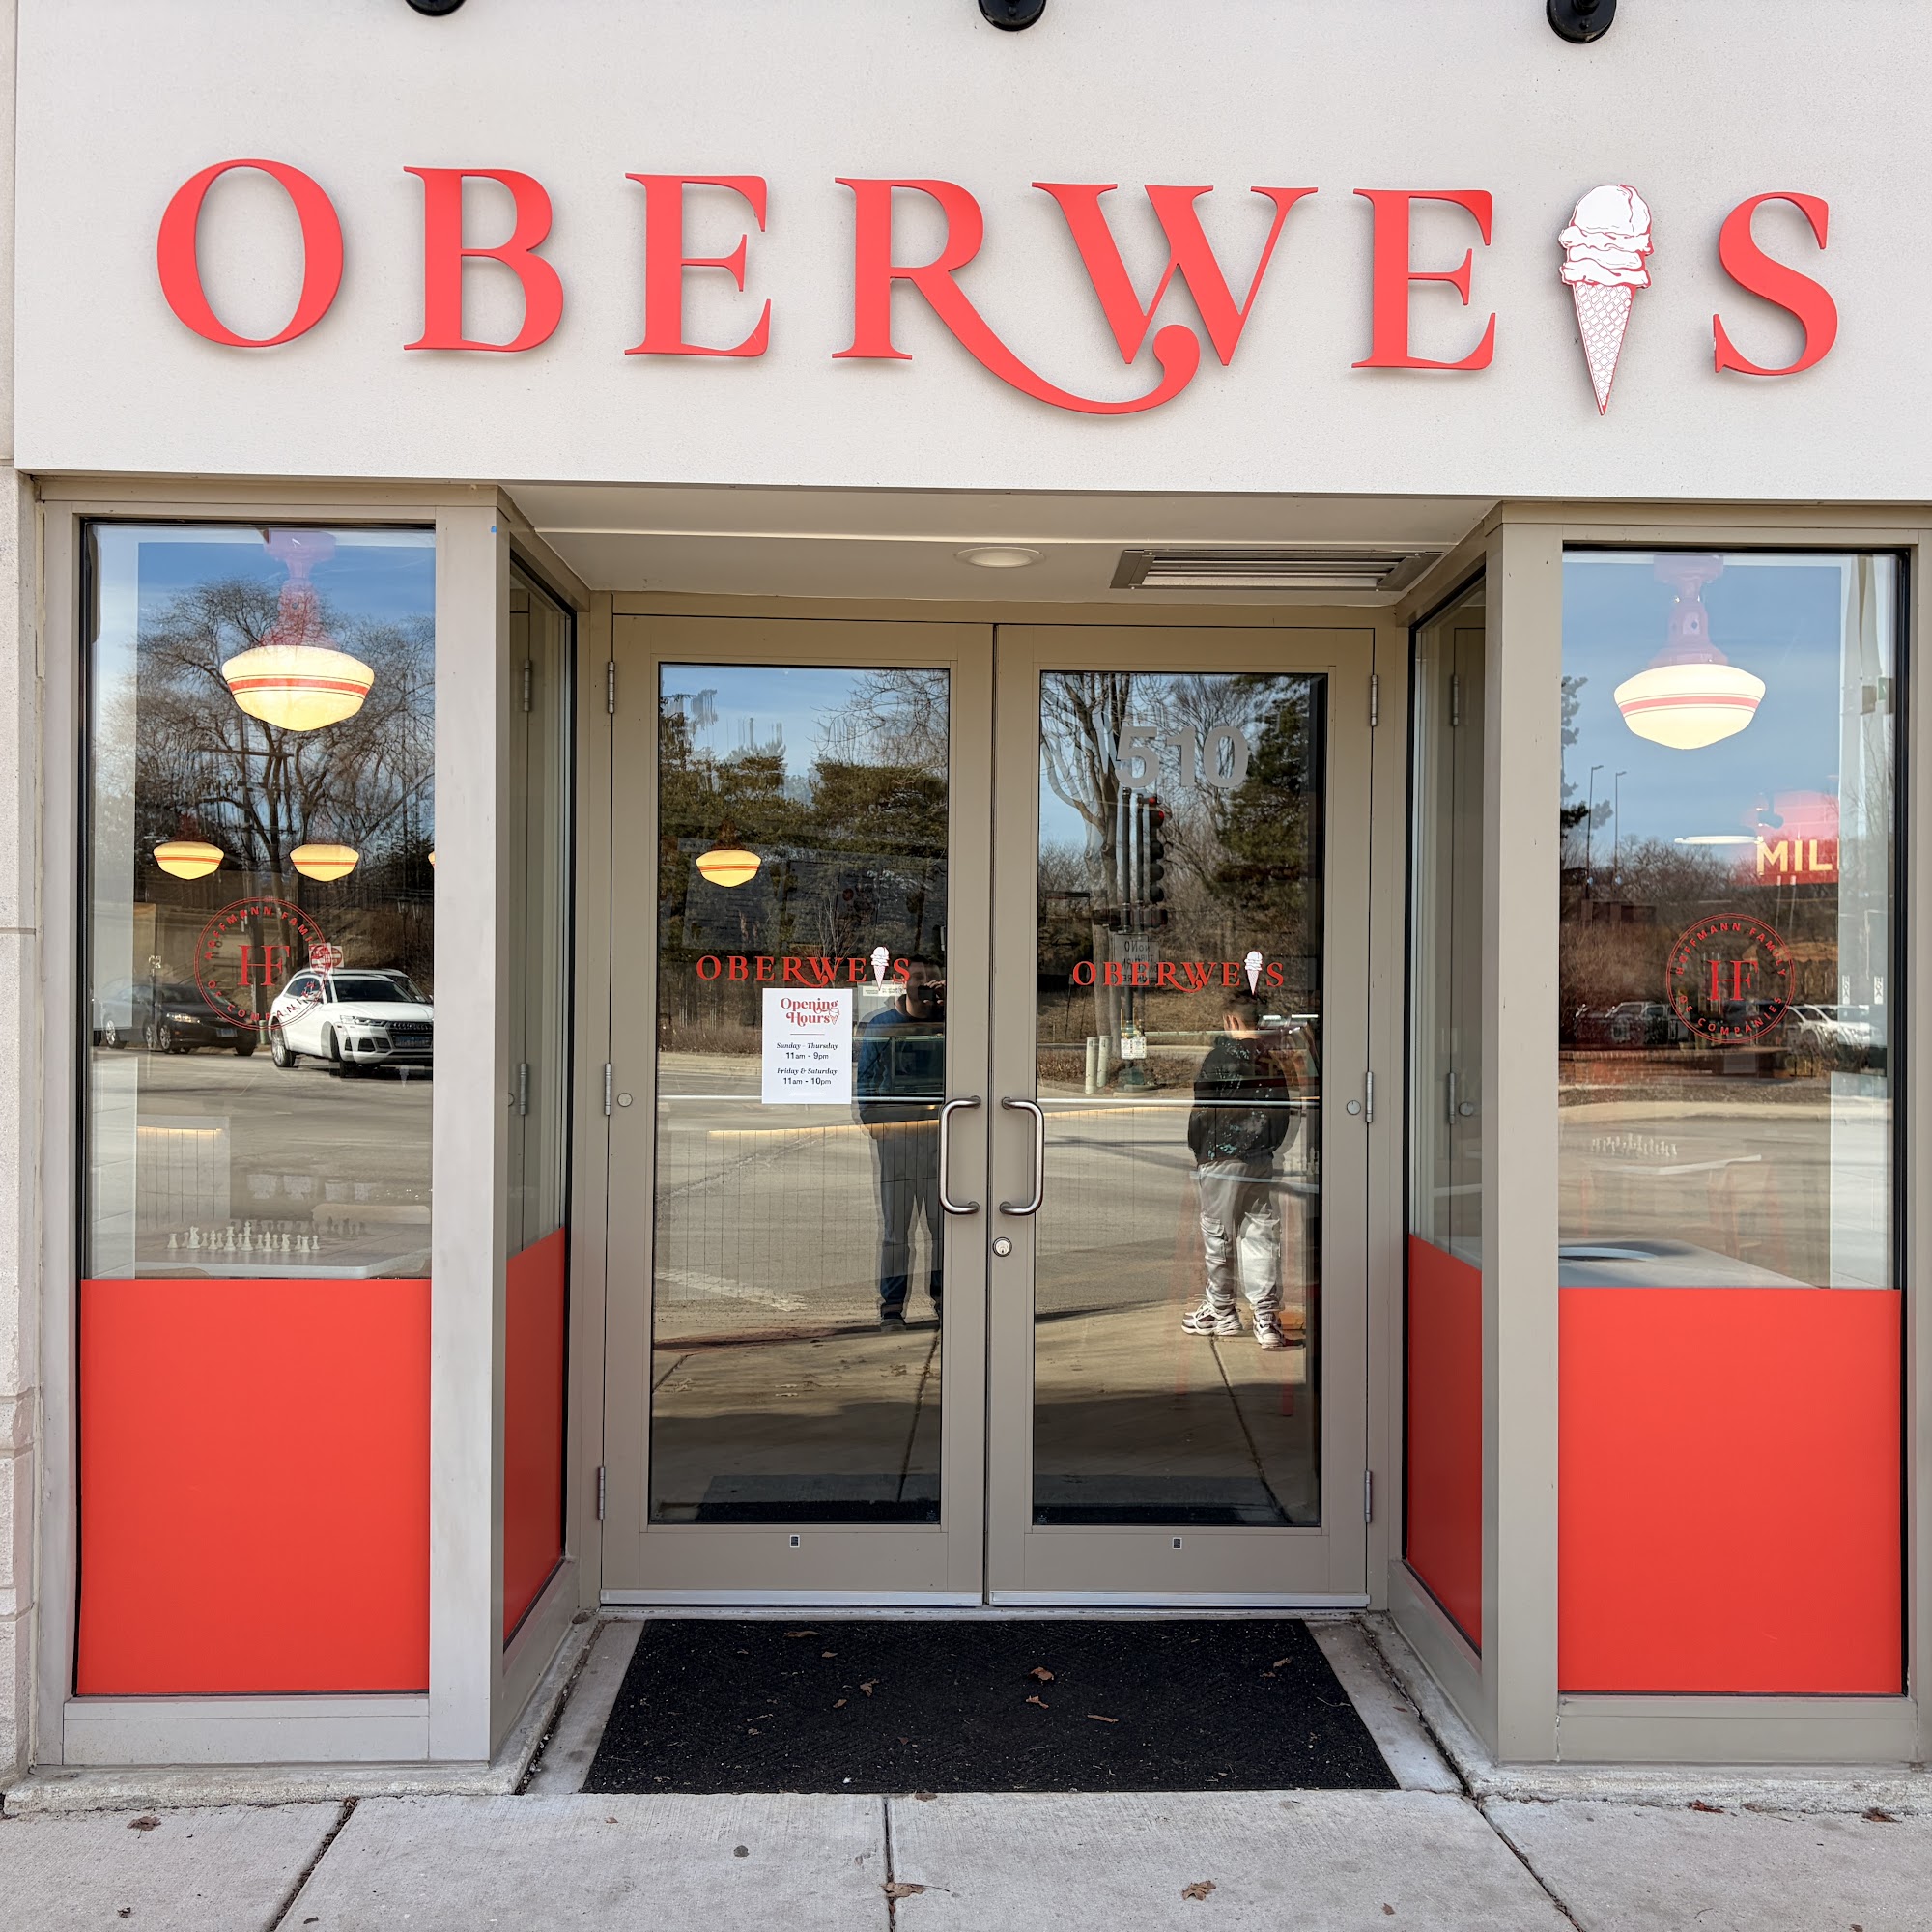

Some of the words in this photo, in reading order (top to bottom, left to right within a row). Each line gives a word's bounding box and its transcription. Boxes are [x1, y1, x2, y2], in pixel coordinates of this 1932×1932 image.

[1115, 725, 1251, 789] 510
[1756, 838, 1839, 872] MIL
[1676, 923, 1741, 975] HOFFMANN
[1749, 927, 1786, 976] FAMILY
[238, 945, 290, 986] HF
[1707, 960, 1758, 1001] HF
[780, 997, 838, 1014] Opening
[1679, 995, 1693, 1013] OF
[1698, 997, 1782, 1036] COMPANIES
[785, 1011, 831, 1027] Hours
[776, 1042, 802, 1051] Sunday
[807, 1042, 838, 1051] Thursday
[785, 1051, 806, 1060] 11am
[812, 1051, 830, 1061] 9pm
[777, 1067, 800, 1076] Friday
[807, 1067, 838, 1076] Saturday
[810, 1077, 832, 1086] 10pm
